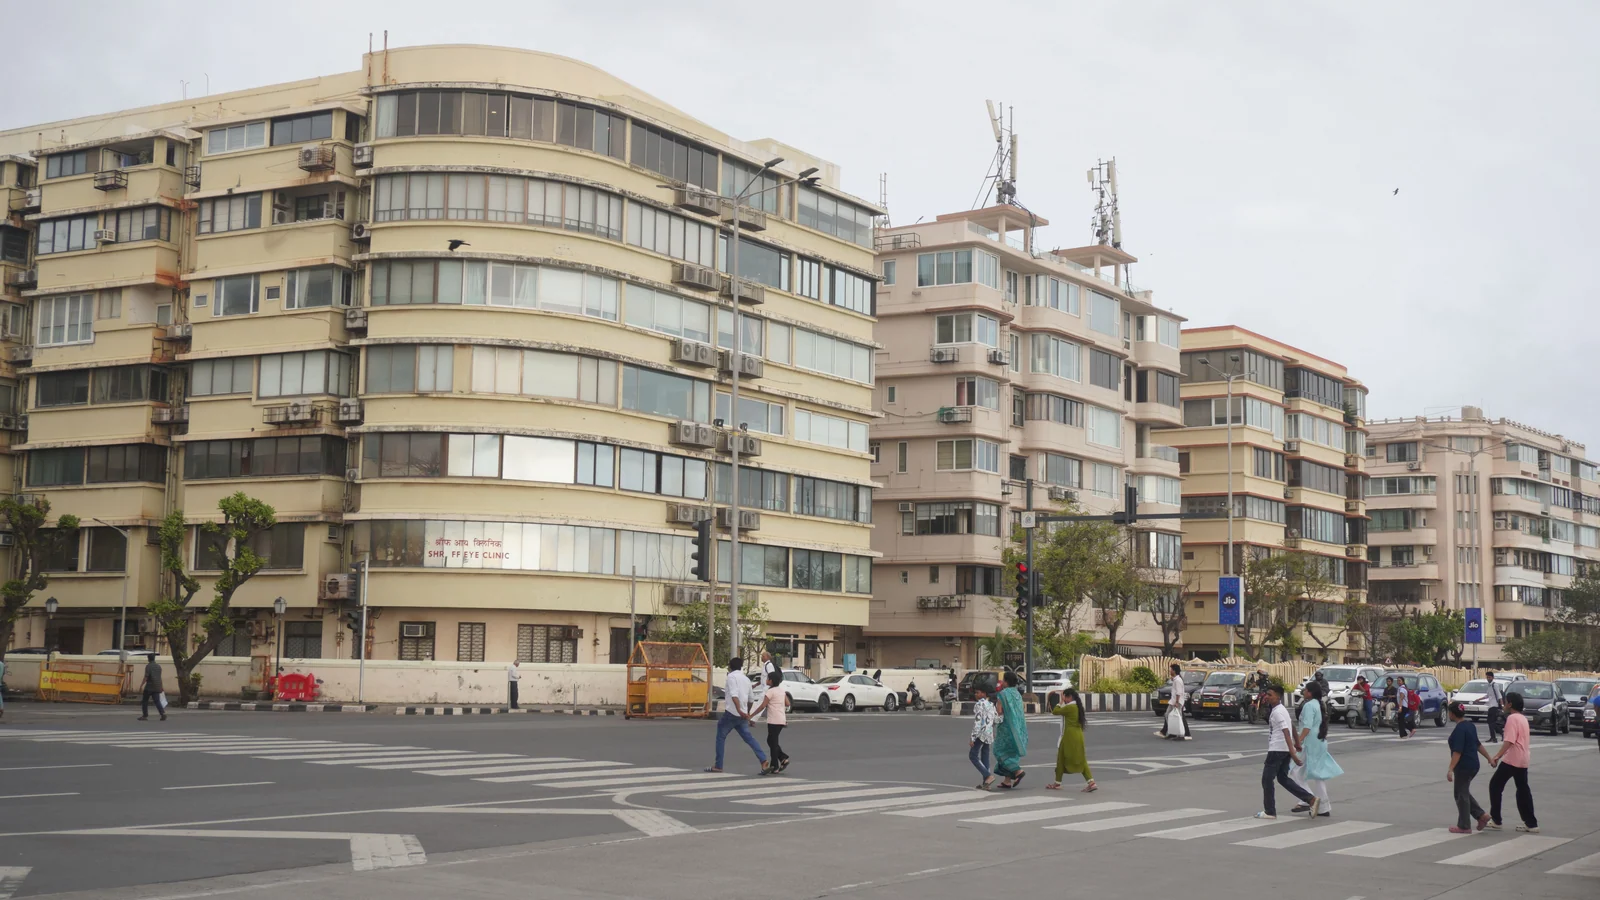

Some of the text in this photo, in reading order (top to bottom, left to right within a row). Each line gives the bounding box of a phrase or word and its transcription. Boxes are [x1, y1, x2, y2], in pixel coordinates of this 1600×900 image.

[428, 550, 510, 560] SHRFF EYE CLINIC
[1223, 596, 1236, 605] Jio
[1468, 621, 1479, 629] Jio
